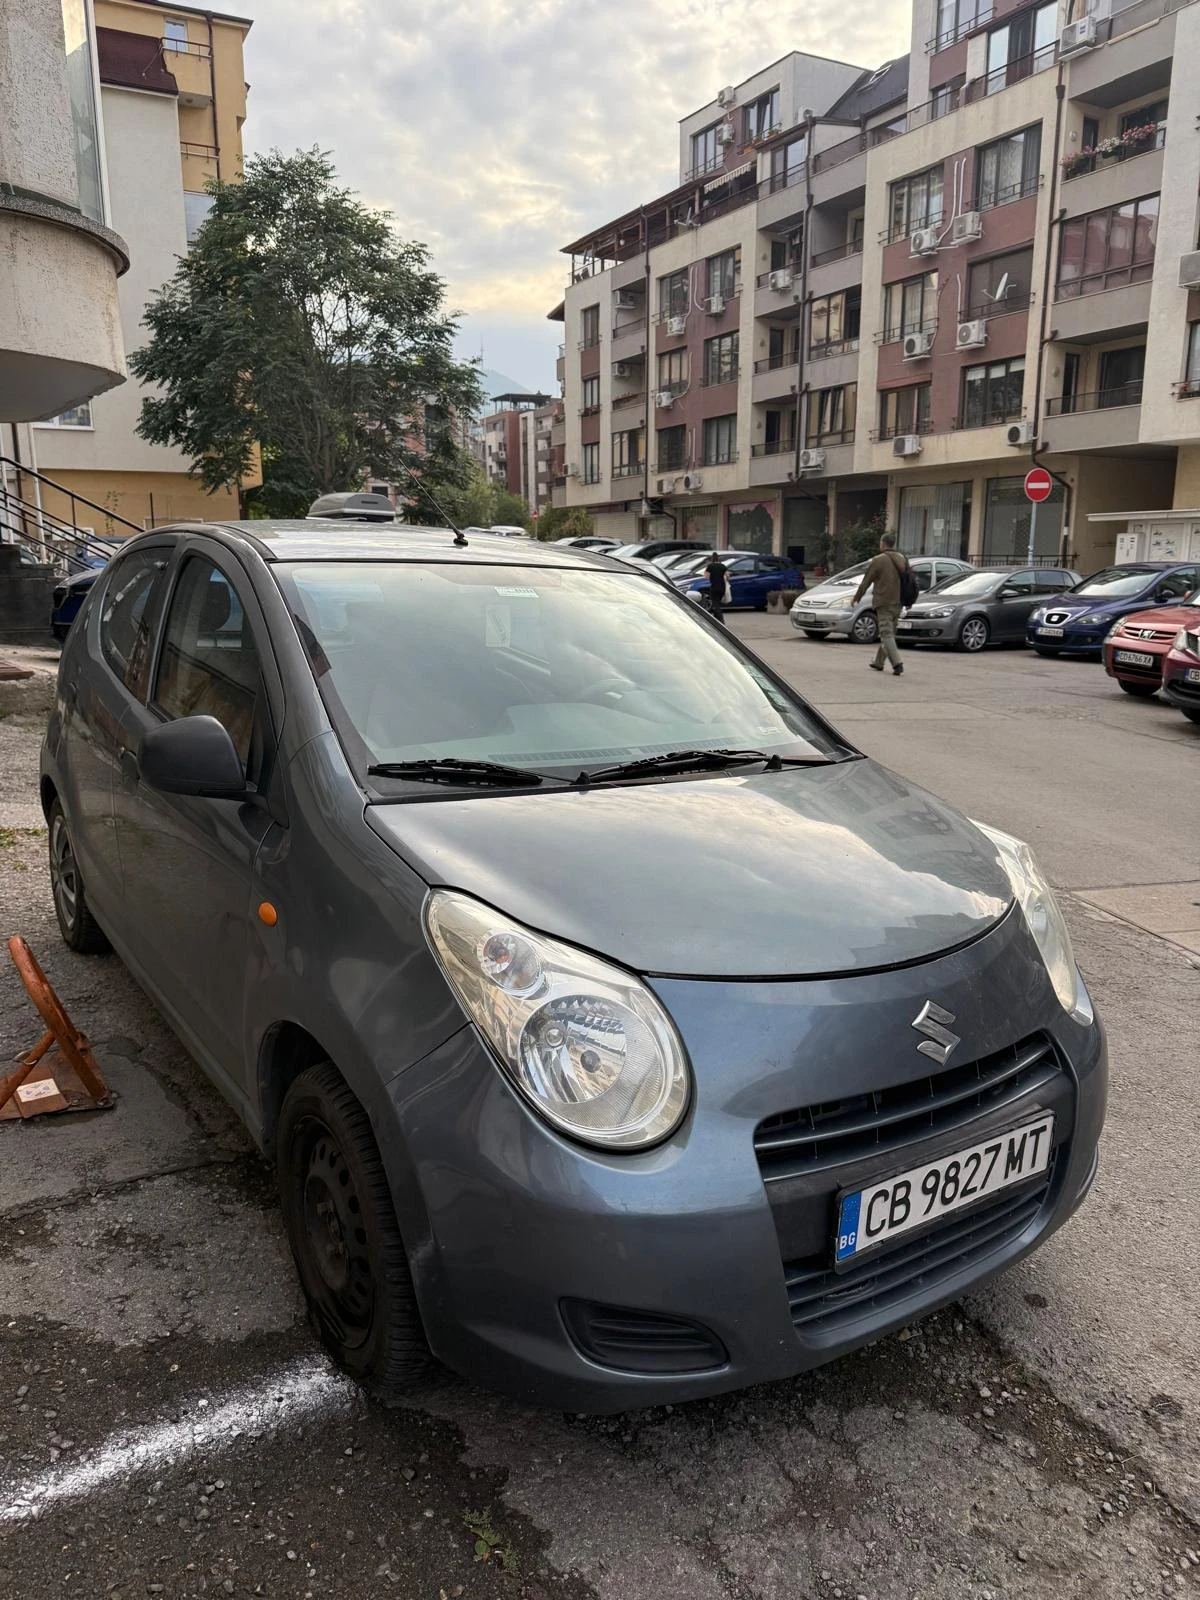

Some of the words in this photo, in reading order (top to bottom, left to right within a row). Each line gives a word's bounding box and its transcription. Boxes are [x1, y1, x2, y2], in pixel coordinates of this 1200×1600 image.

[865, 1180, 912, 1238] CB
[921, 1143, 1002, 1216] 9827
[1004, 1125, 1047, 1179] MT
[840, 1231, 856, 1249] BG
